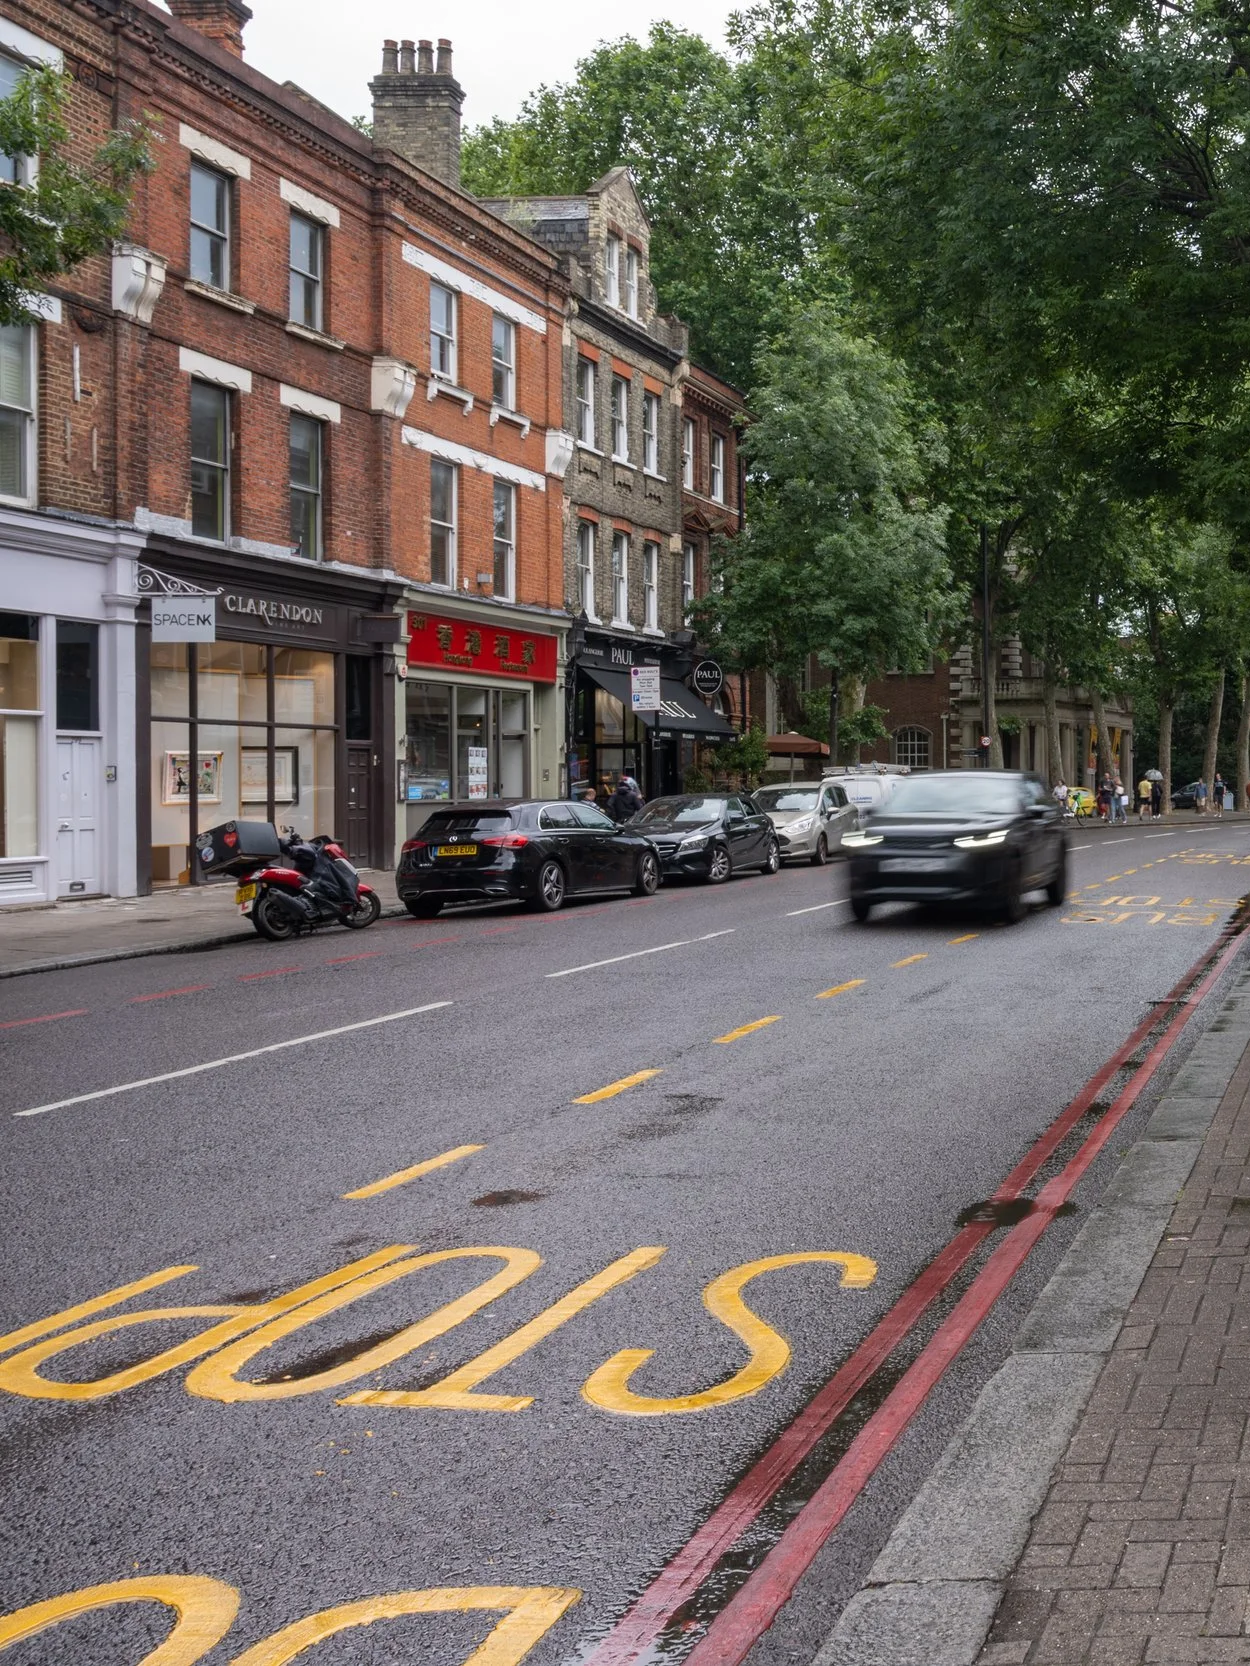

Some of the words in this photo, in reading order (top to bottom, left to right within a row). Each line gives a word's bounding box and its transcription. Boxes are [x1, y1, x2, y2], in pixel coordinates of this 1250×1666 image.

[224, 595, 323, 625] CLARENDON
[611, 647, 634, 665] PAUL
[697, 670, 720, 679] PAUL
[1060, 910, 1219, 925] BUS
[0, 1244, 877, 1414] STOP
